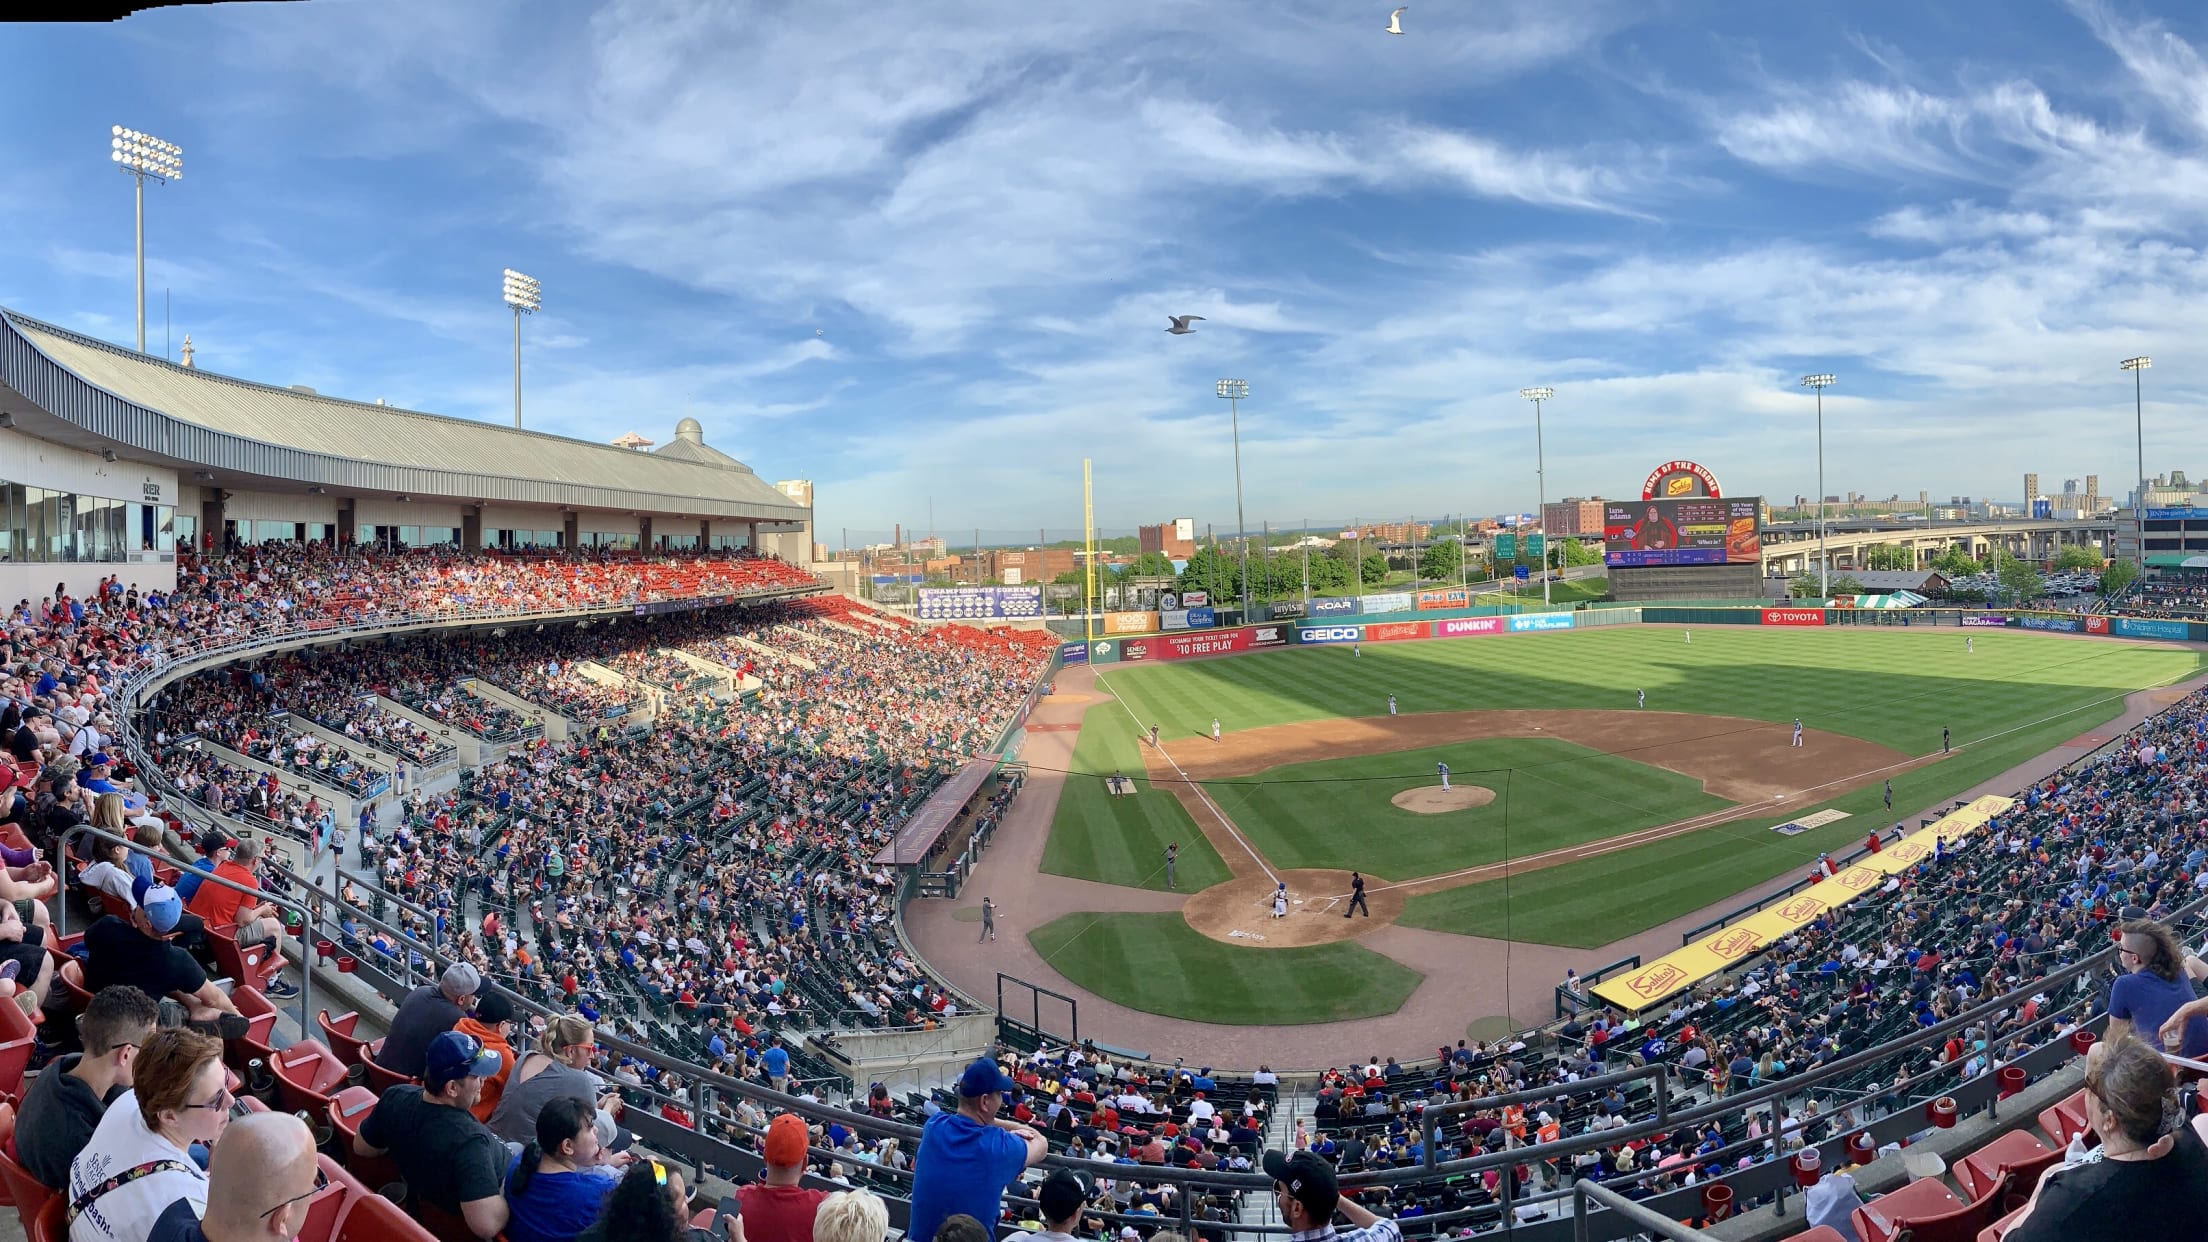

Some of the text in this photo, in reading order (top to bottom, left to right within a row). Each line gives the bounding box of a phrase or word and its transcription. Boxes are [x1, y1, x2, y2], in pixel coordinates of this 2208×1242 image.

[1644, 461, 1718, 494] HOME OF THE BISONS
[143, 483, 160, 495] RER
[927, 587, 995, 595] CHAMPIONSHIP
[1163, 598, 1174, 607] 42
[1316, 601, 1352, 611] ROAR
[1117, 614, 1147, 623] NOCO
[1782, 613, 1818, 621] TOYOTA
[1446, 619, 1496, 632] DUNKIN'
[1301, 628, 1358, 641] GEICO
[1177, 640, 1232, 655] $10 FREE PLAY
[90, 1152, 107, 1183] SENEC
